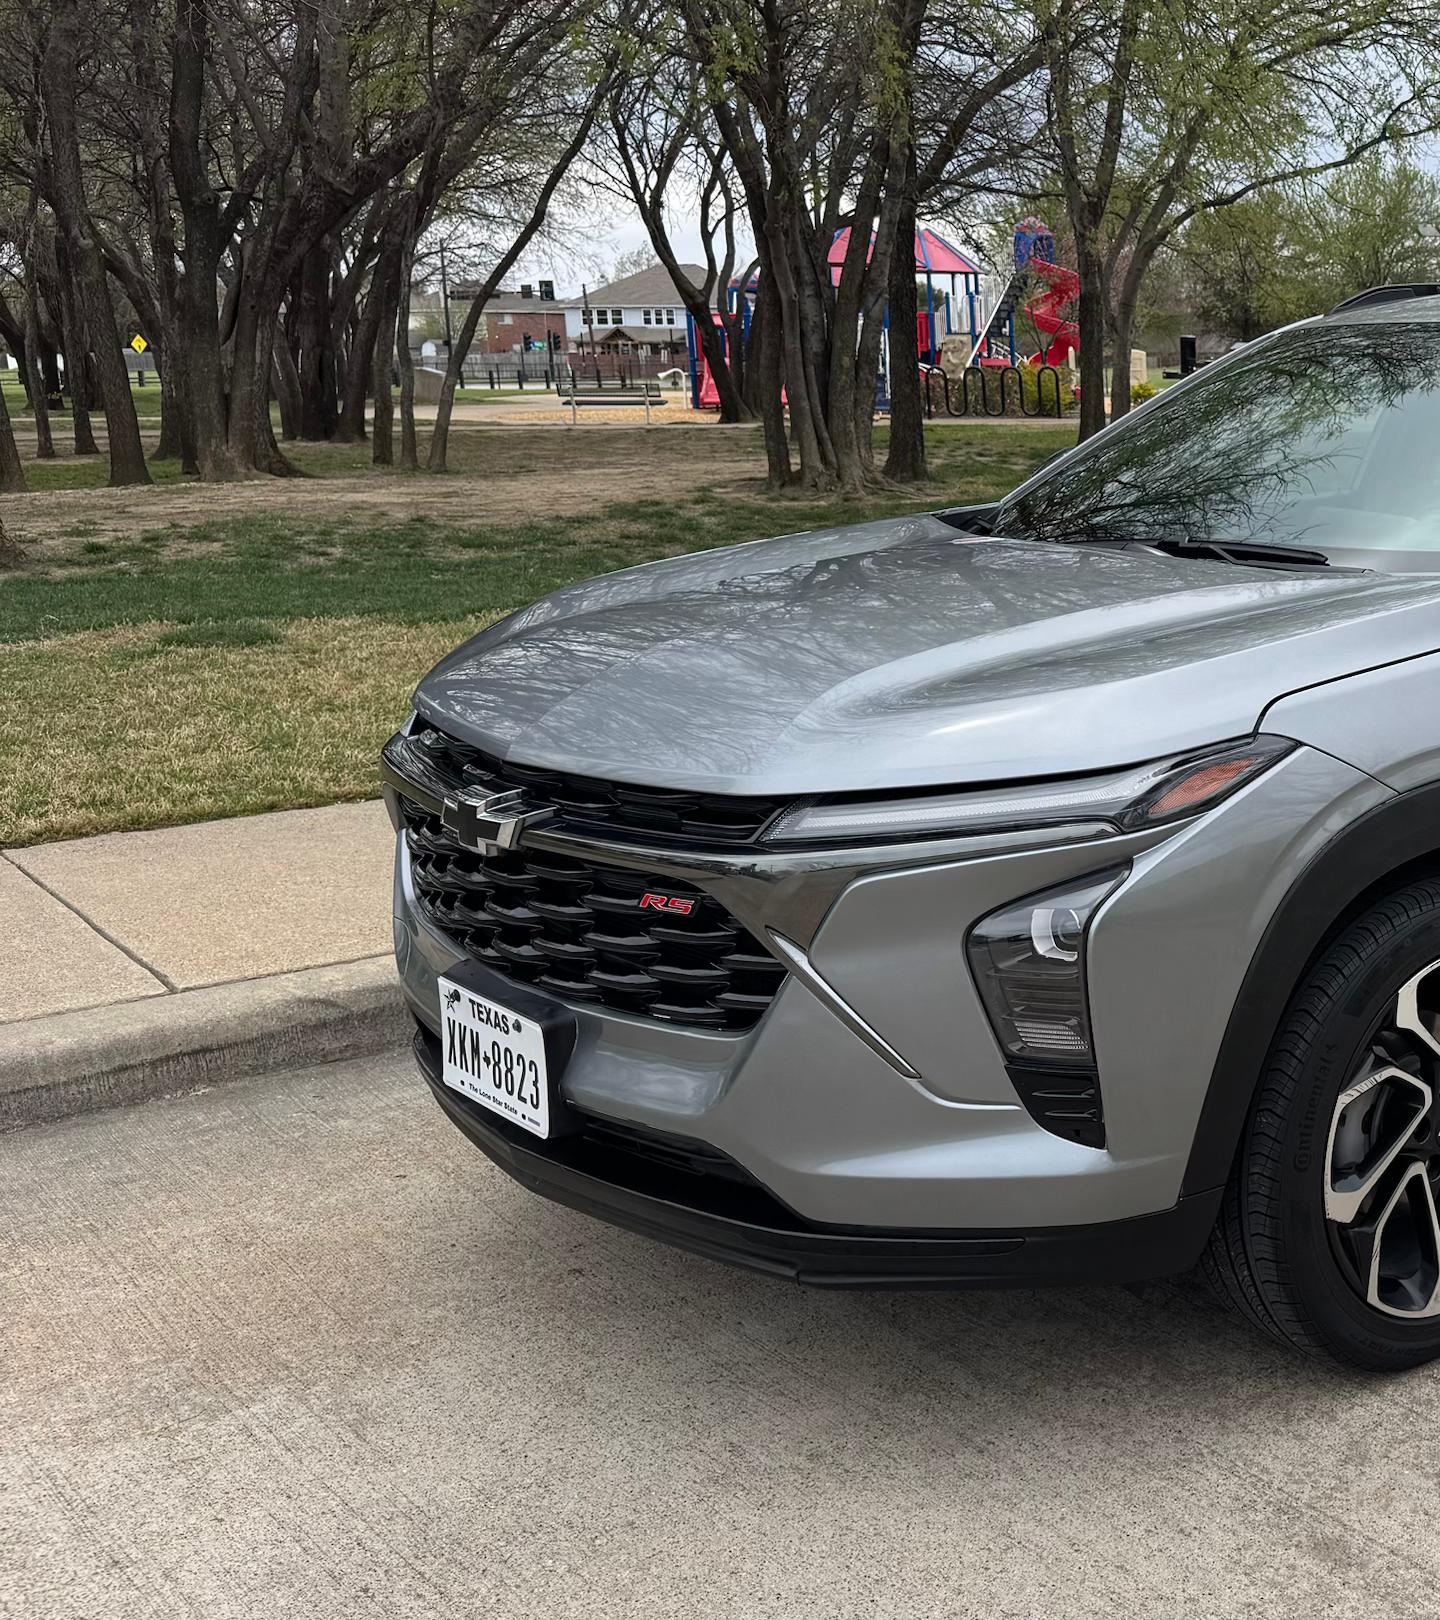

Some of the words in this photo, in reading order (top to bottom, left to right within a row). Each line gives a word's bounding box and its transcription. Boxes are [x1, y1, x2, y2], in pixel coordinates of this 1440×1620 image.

[639, 893, 695, 915] RS
[468, 998, 510, 1035] TEXAS
[468, 1083, 478, 1094] The
[479, 1088, 492, 1101] Lone
[492, 1096, 503, 1107] Star
[504, 1102, 518, 1115] State
[1294, 1057, 1335, 1172] Continental
